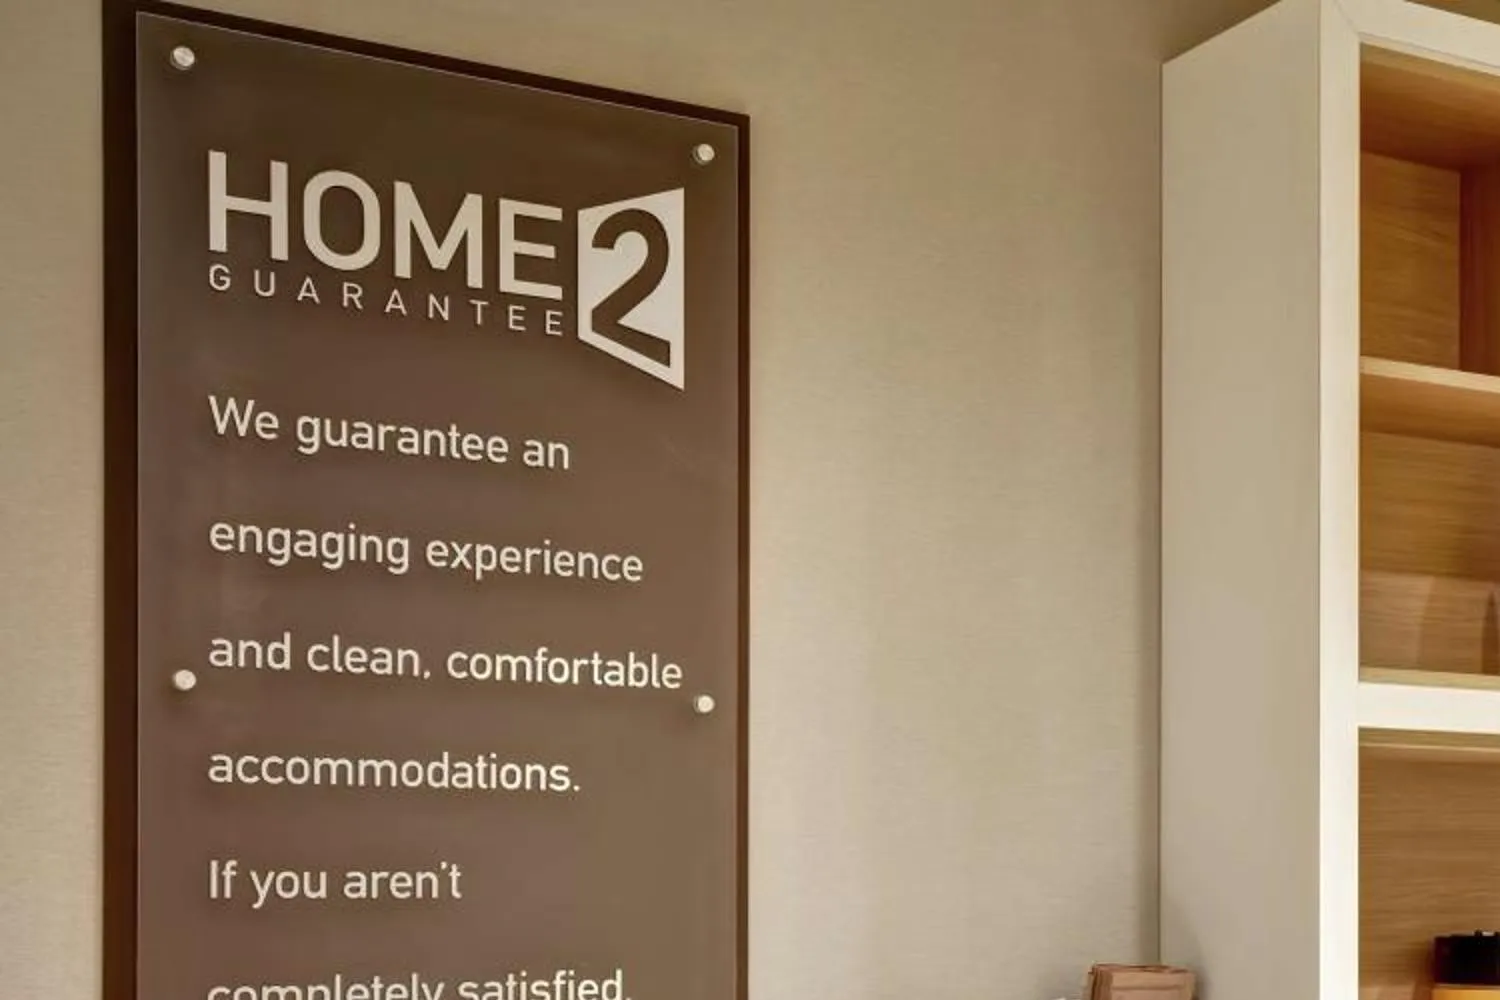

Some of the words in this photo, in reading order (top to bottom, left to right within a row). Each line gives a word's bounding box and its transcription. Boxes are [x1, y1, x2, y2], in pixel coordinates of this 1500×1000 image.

[208, 264, 563, 337] GUARANTEE
[208, 395, 279, 440] We
[296, 415, 509, 463] guarantee
[523, 439, 570, 470] an
[209, 522, 409, 575] engaging
[426, 539, 643, 582] experience
[209, 632, 291, 670] and
[307, 634, 431, 680] clean,
[447, 646, 683, 689] comfortable
[209, 751, 580, 792] accommodations.
[210, 859, 238, 899] If
[250, 871, 327, 909] you
[343, 861, 462, 899] aren't
